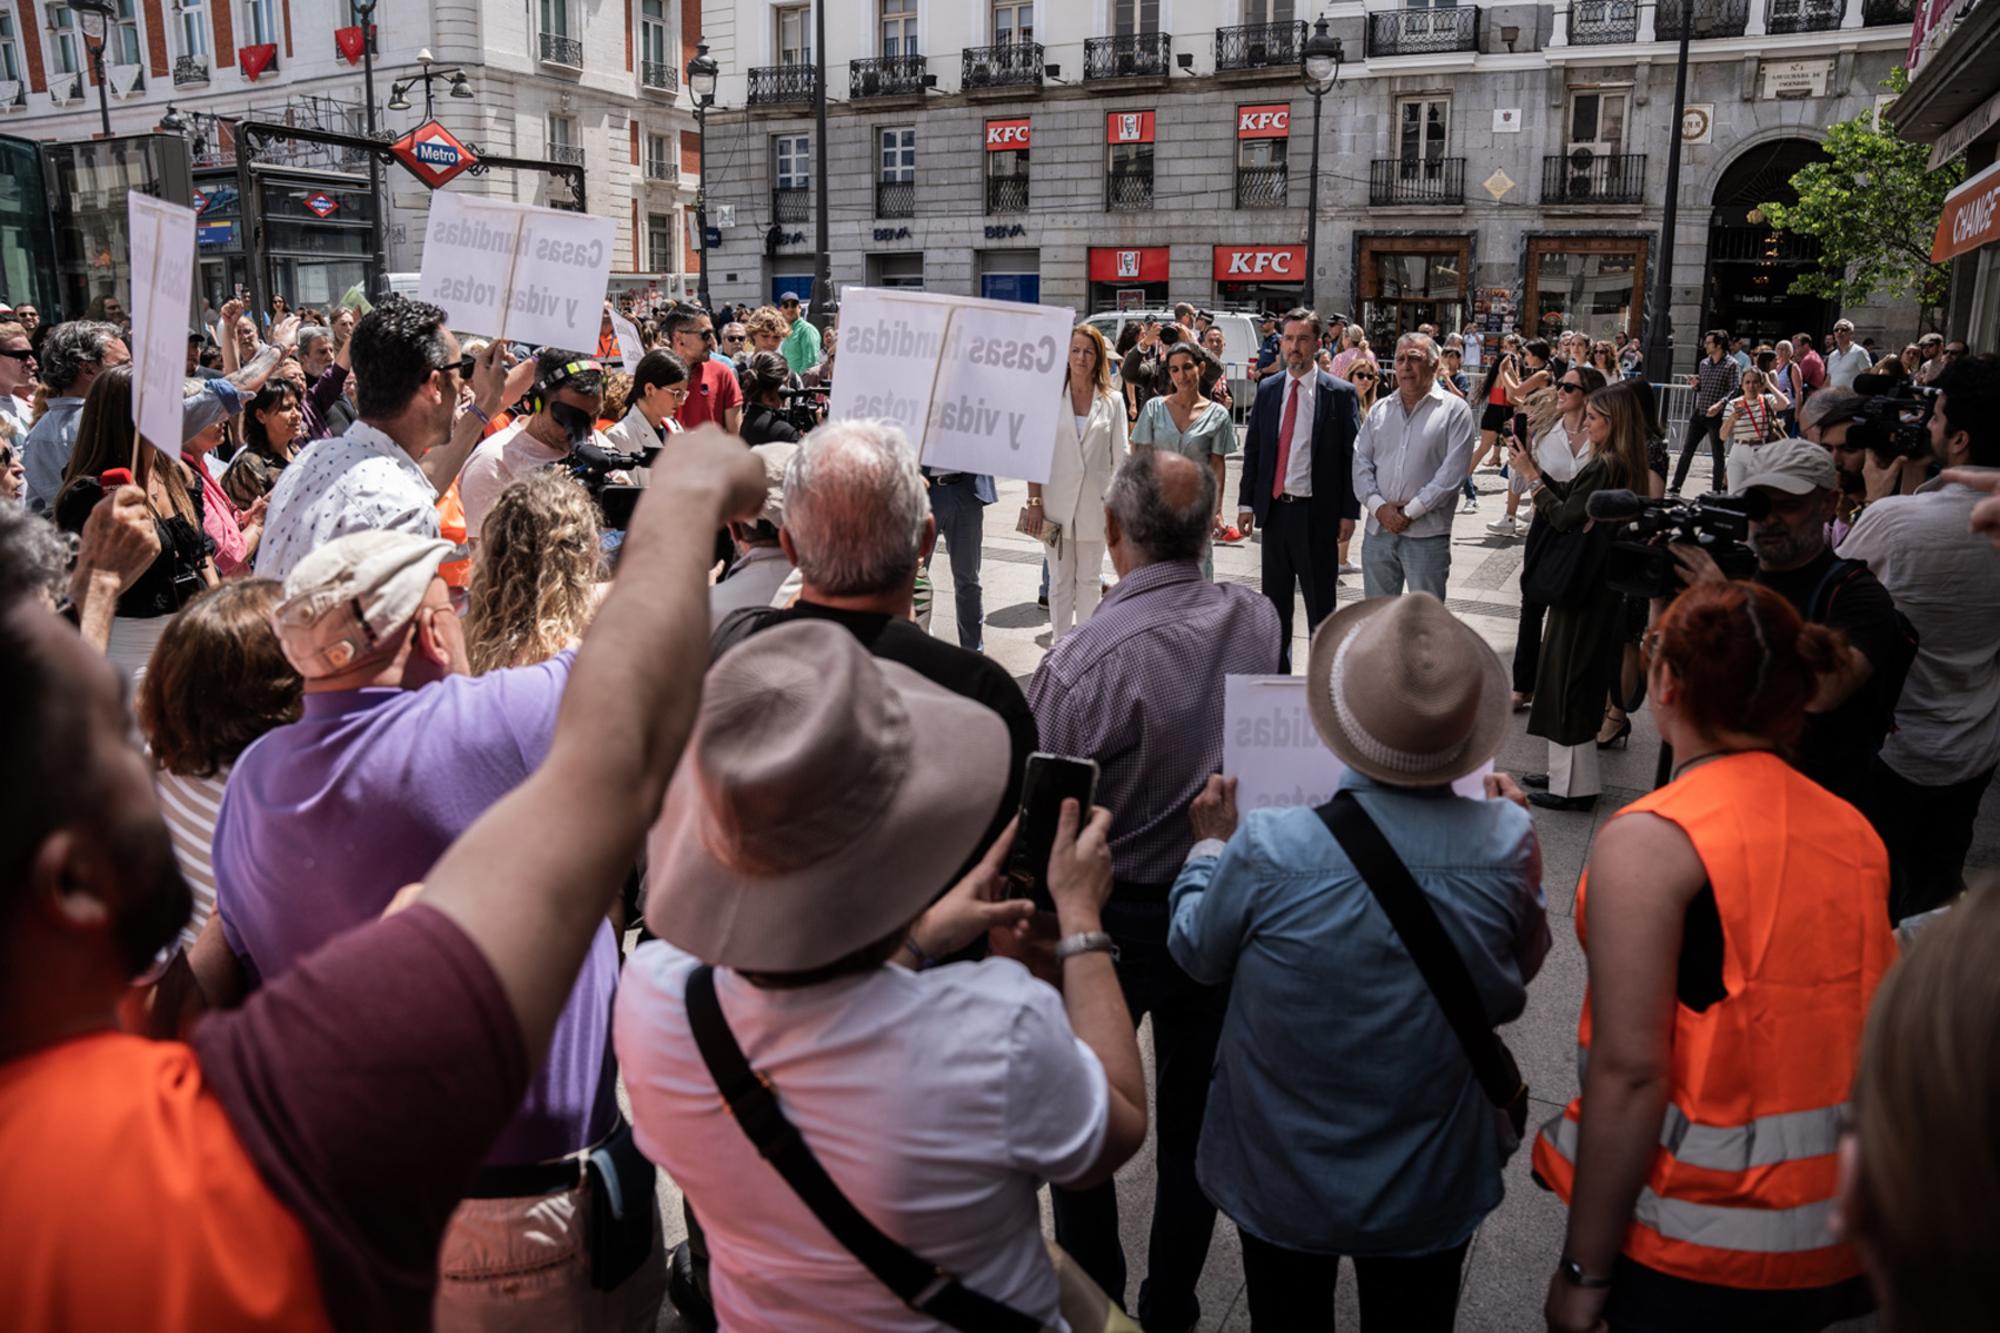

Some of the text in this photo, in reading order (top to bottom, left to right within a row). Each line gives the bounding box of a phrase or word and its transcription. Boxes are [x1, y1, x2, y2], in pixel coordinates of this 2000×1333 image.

[1238, 111, 1289, 131] KFC
[986, 126, 1029, 143] KFC
[420, 144, 456, 163] Metro
[1952, 186, 2000, 246] CHANGE
[873, 226, 912, 241] BBVA
[984, 223, 1026, 239] BBVA
[1228, 252, 1292, 274] KFC
